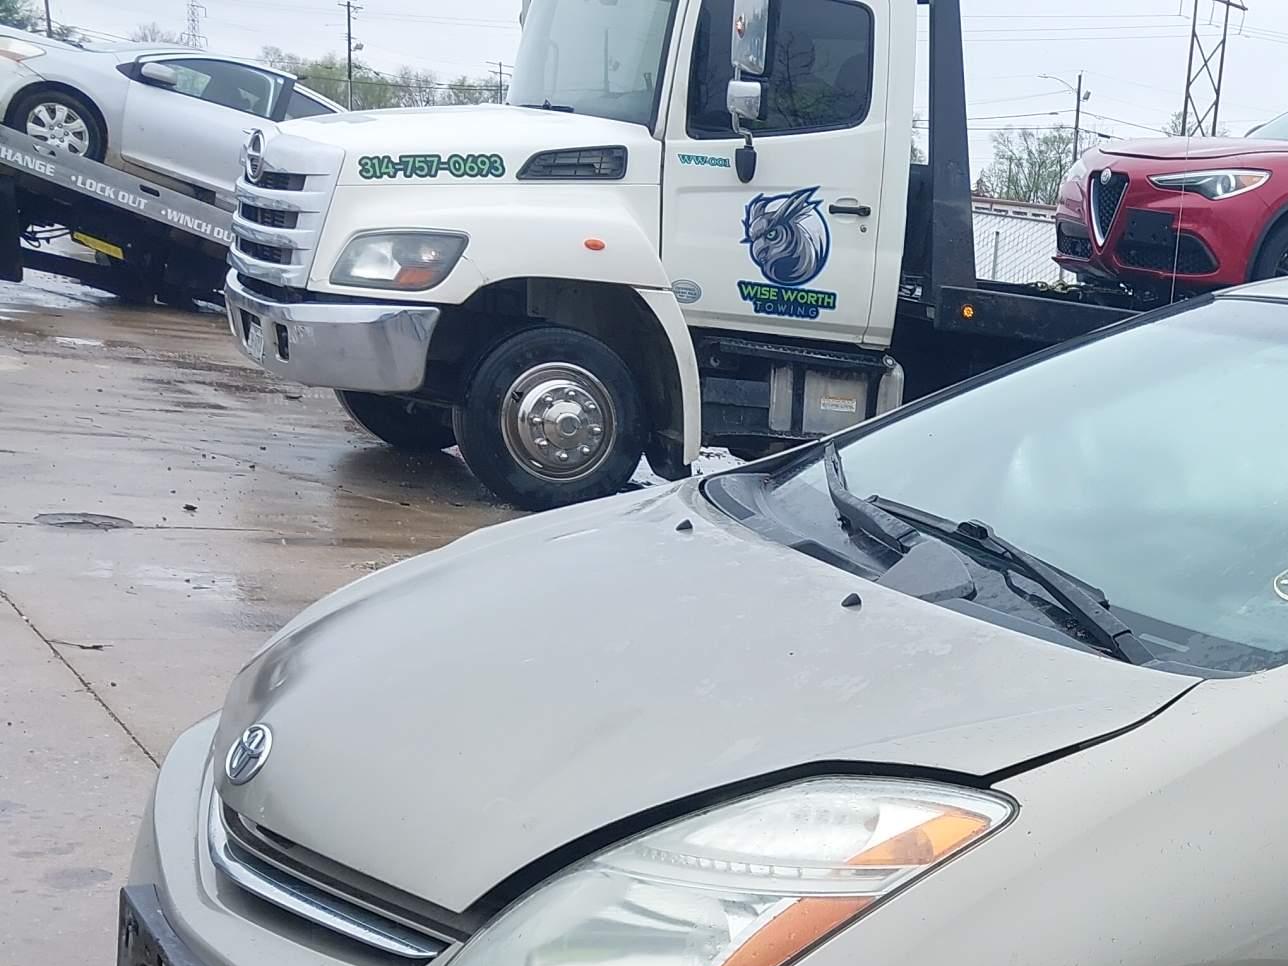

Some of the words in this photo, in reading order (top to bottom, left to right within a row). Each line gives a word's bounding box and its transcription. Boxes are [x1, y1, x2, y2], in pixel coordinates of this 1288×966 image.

[359, 153, 505, 178] 314-757-0693
[677, 153, 731, 168] WW-001
[76, 174, 116, 204] LOCK
[118, 190, 148, 210] OUT
[165, 208, 212, 236] WINCH
[740, 283, 779, 300] WISE
[781, 289, 835, 307] WORTH
[755, 301, 818, 317] TOWING
